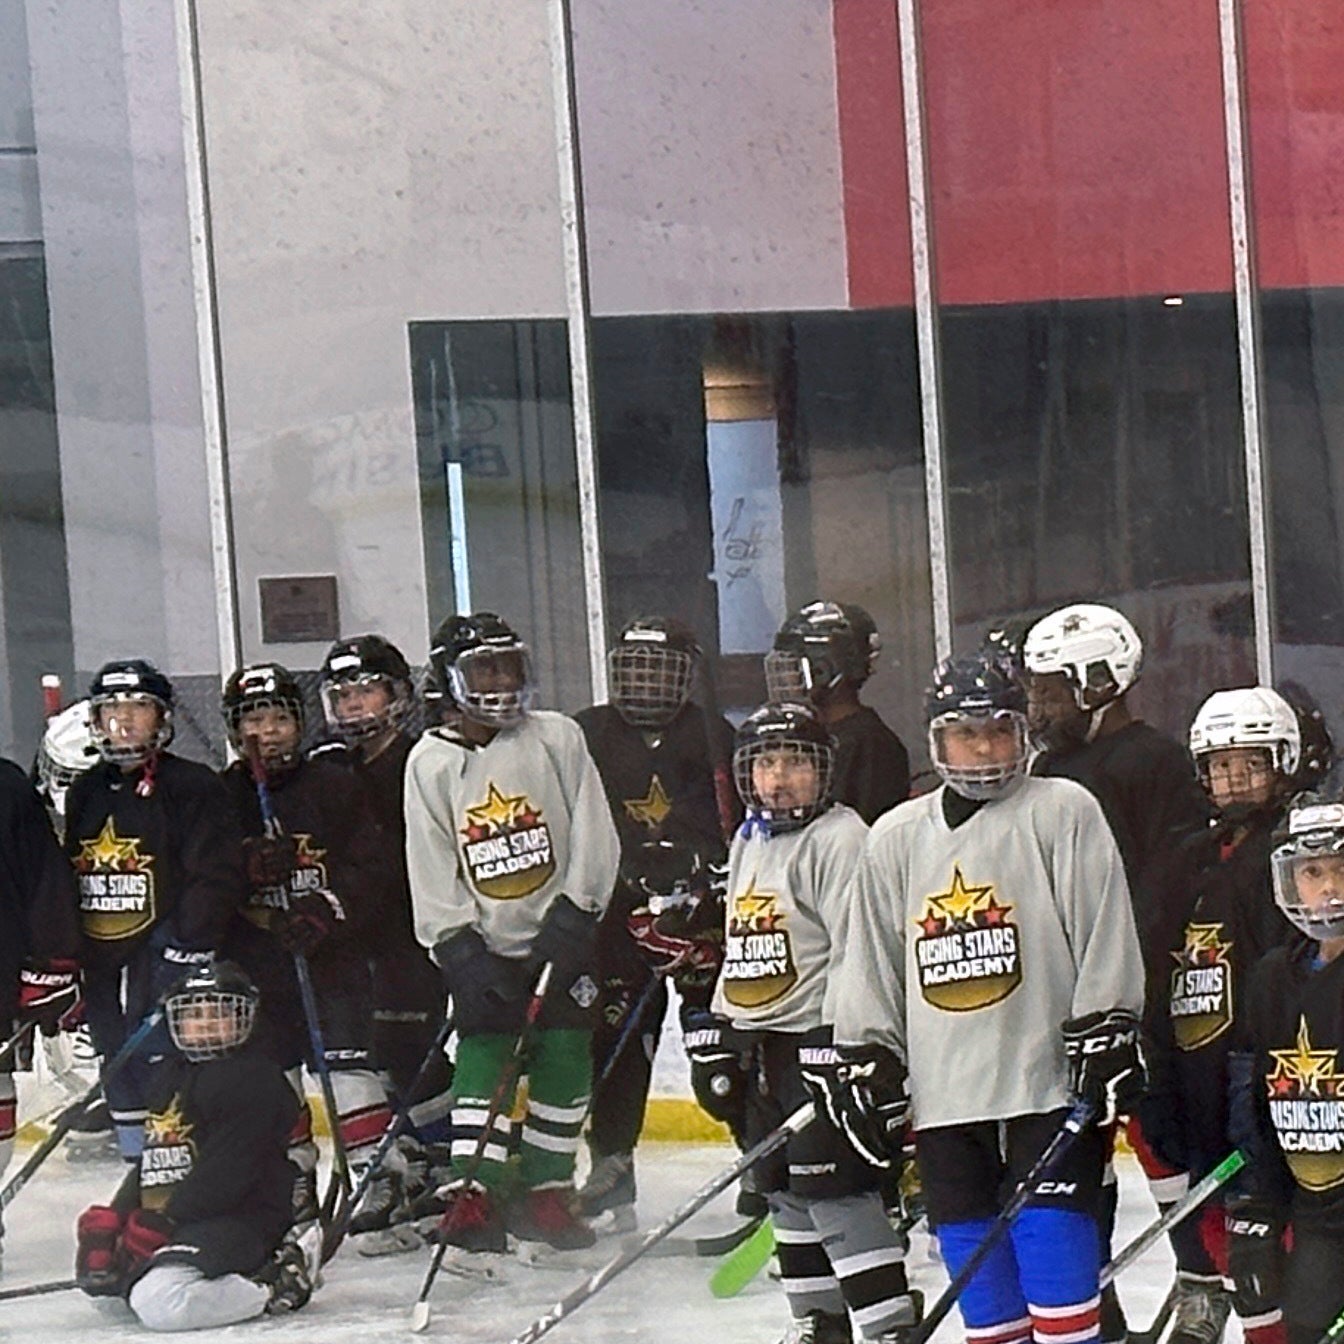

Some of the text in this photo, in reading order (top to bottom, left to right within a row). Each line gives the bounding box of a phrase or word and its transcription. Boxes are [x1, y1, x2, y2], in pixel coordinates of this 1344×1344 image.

[510, 826, 550, 858] STARS
[475, 850, 552, 881] ACADEMY
[108, 874, 147, 896] STARS
[744, 933, 787, 961] STARS
[919, 926, 1016, 967] RISING STARS
[924, 955, 1017, 986] ACADEMY
